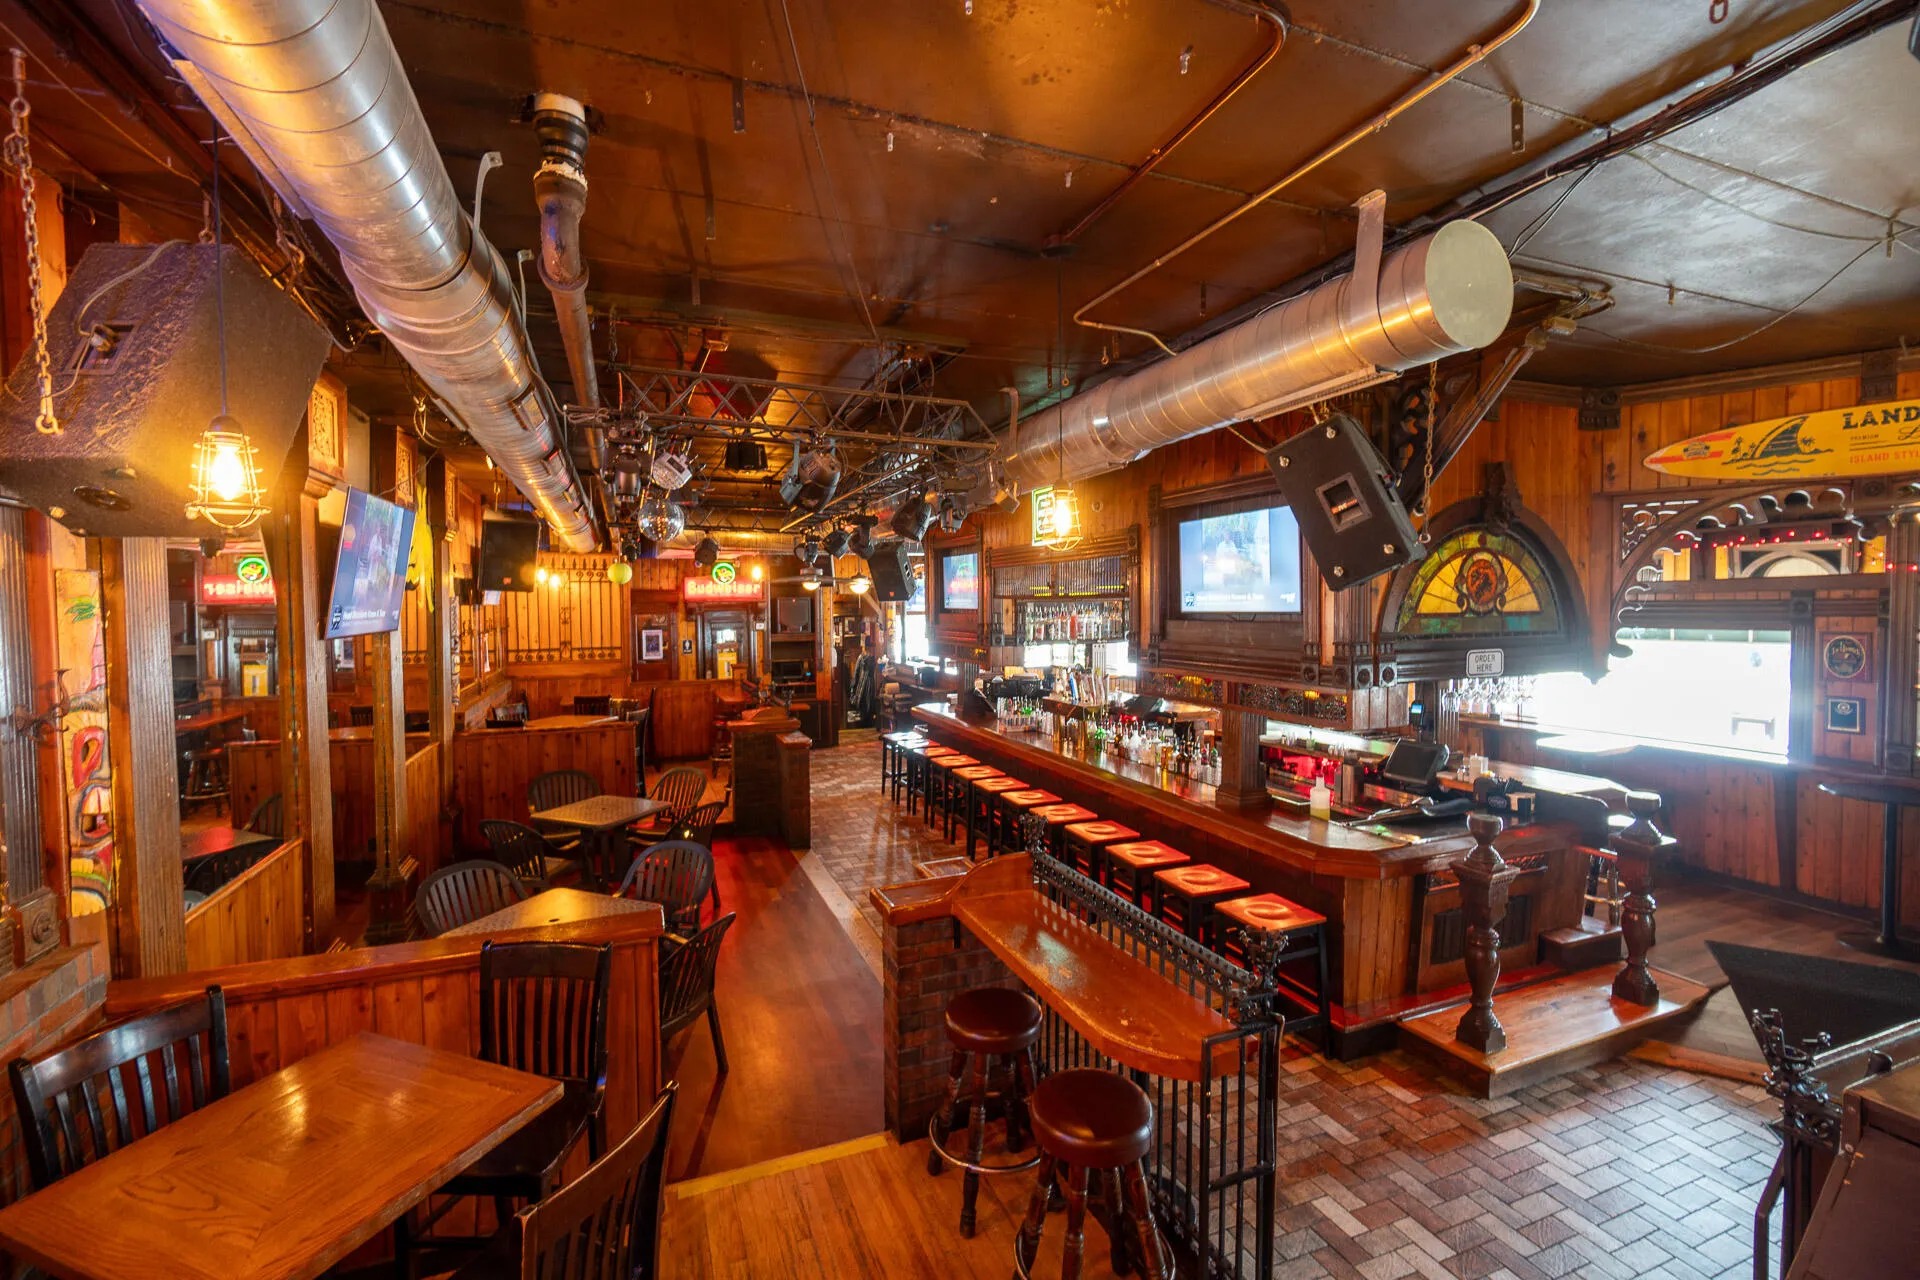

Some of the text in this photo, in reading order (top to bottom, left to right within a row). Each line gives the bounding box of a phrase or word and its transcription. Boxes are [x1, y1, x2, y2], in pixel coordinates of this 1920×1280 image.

[1843, 406, 1920, 429] LAND
[1850, 453, 1889, 463] ISLAND
[687, 581, 760, 595] Budweiser
[1475, 654, 1495, 663] ORDER
[1476, 664, 1492, 672] HERE
